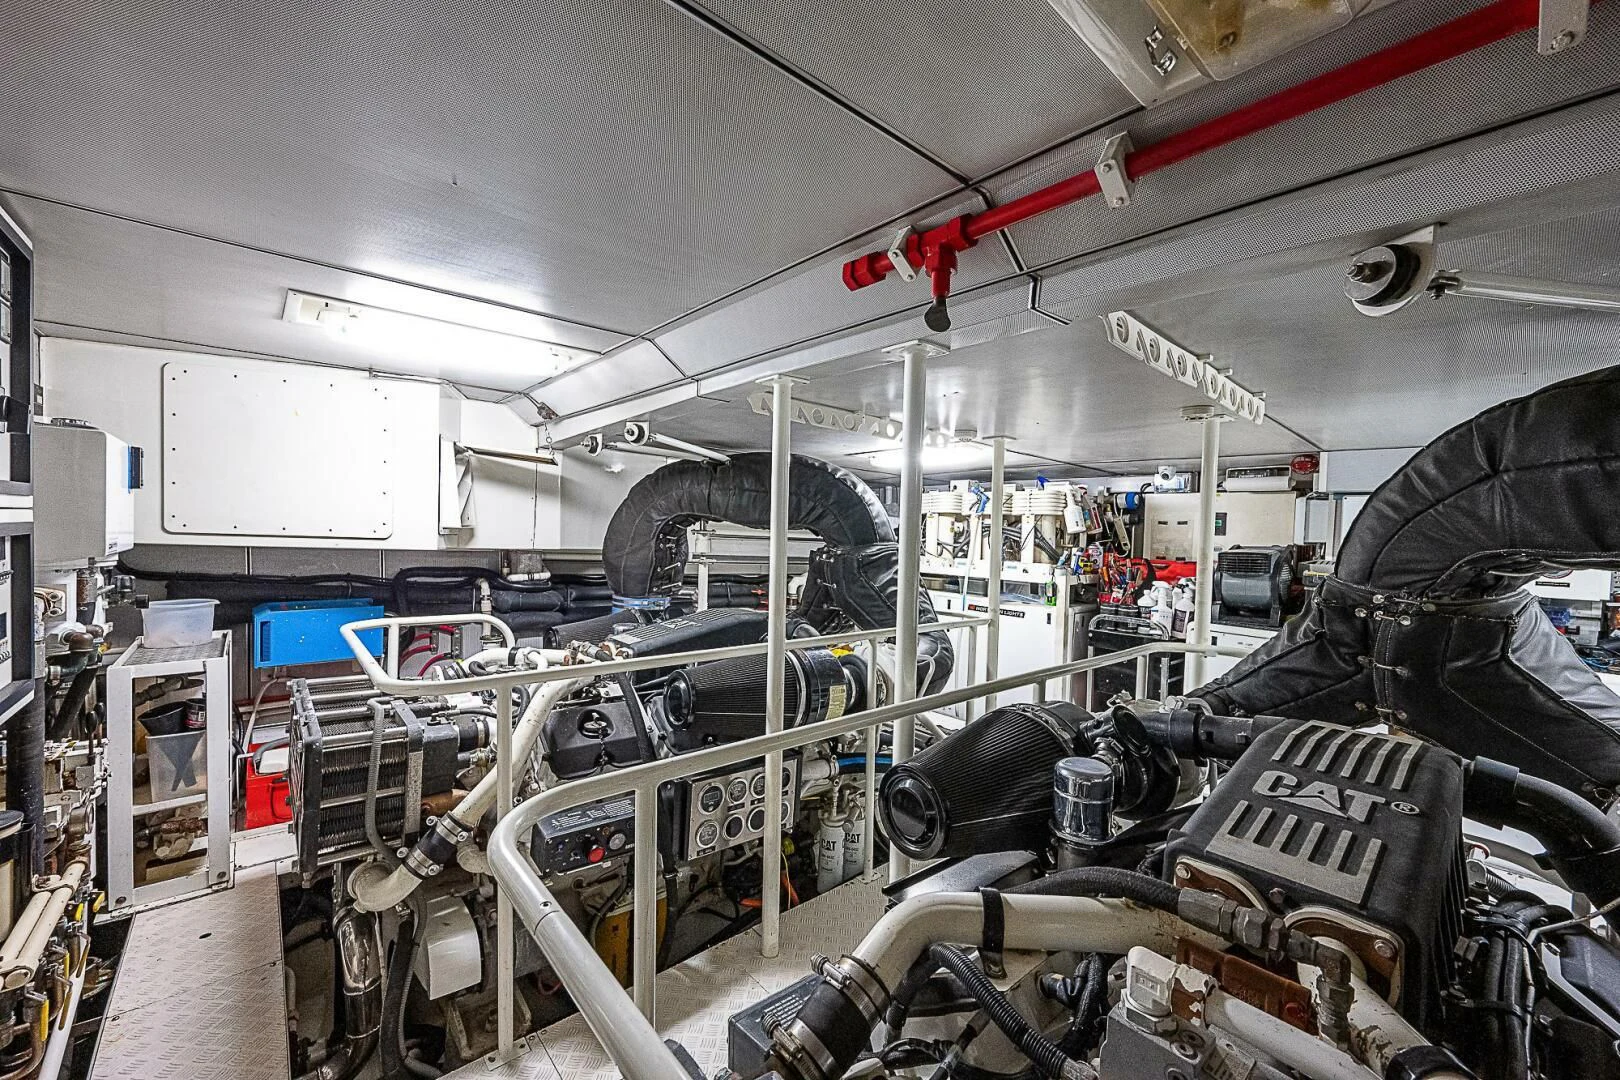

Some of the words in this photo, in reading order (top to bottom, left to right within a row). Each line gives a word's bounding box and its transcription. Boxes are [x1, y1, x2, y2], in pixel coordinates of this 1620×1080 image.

[1252, 770, 1386, 823] CAT
[821, 838, 837, 852] CAT
[845, 832, 861, 844] CAT
